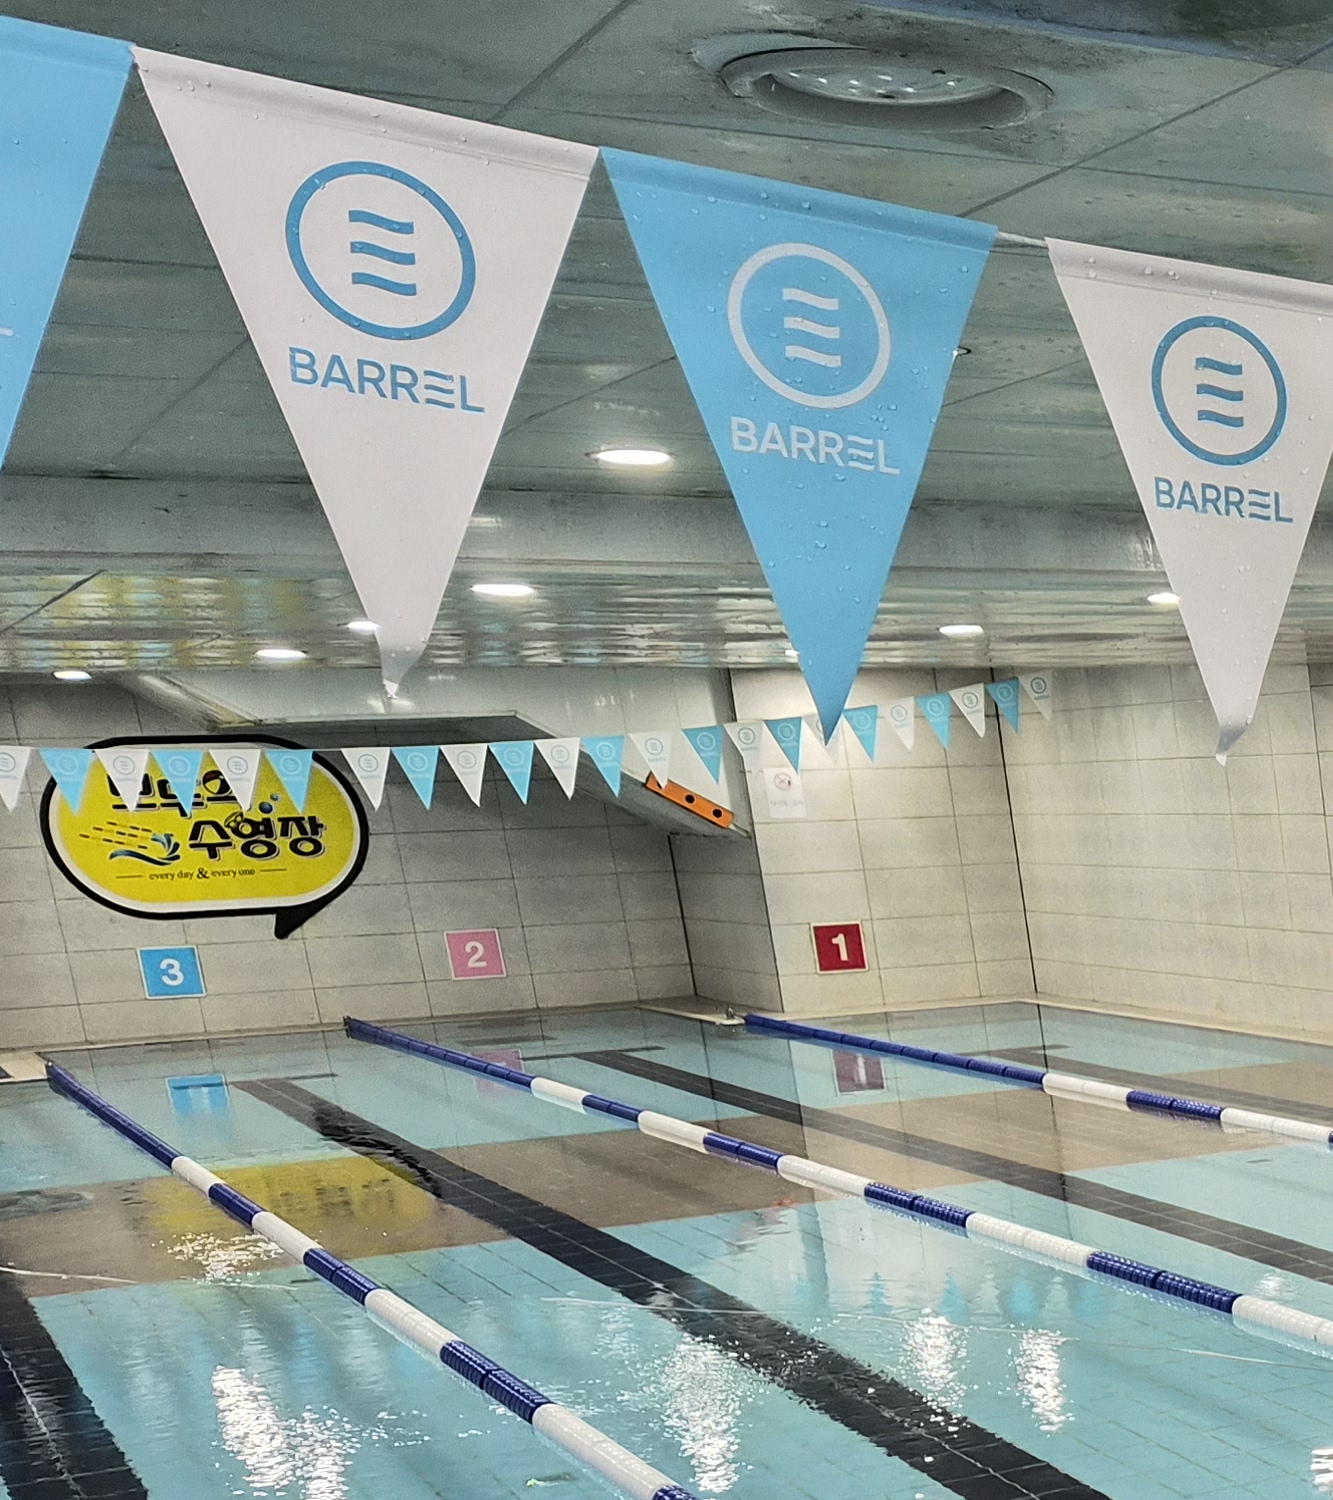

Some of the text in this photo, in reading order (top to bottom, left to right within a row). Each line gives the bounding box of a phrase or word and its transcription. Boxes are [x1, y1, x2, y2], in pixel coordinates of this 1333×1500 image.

[289, 346, 486, 414] BARREL
[730, 417, 900, 478] BARREL
[1154, 476, 1294, 524] BARREL
[188, 815, 326, 861] 수영장
[148, 872, 175, 881] every
[177, 869, 194, 880] day
[196, 867, 209, 879] &
[211, 870, 238, 879] every
[465, 941, 487, 968] 2
[831, 932, 848, 962] 1
[159, 958, 184, 986] 3
